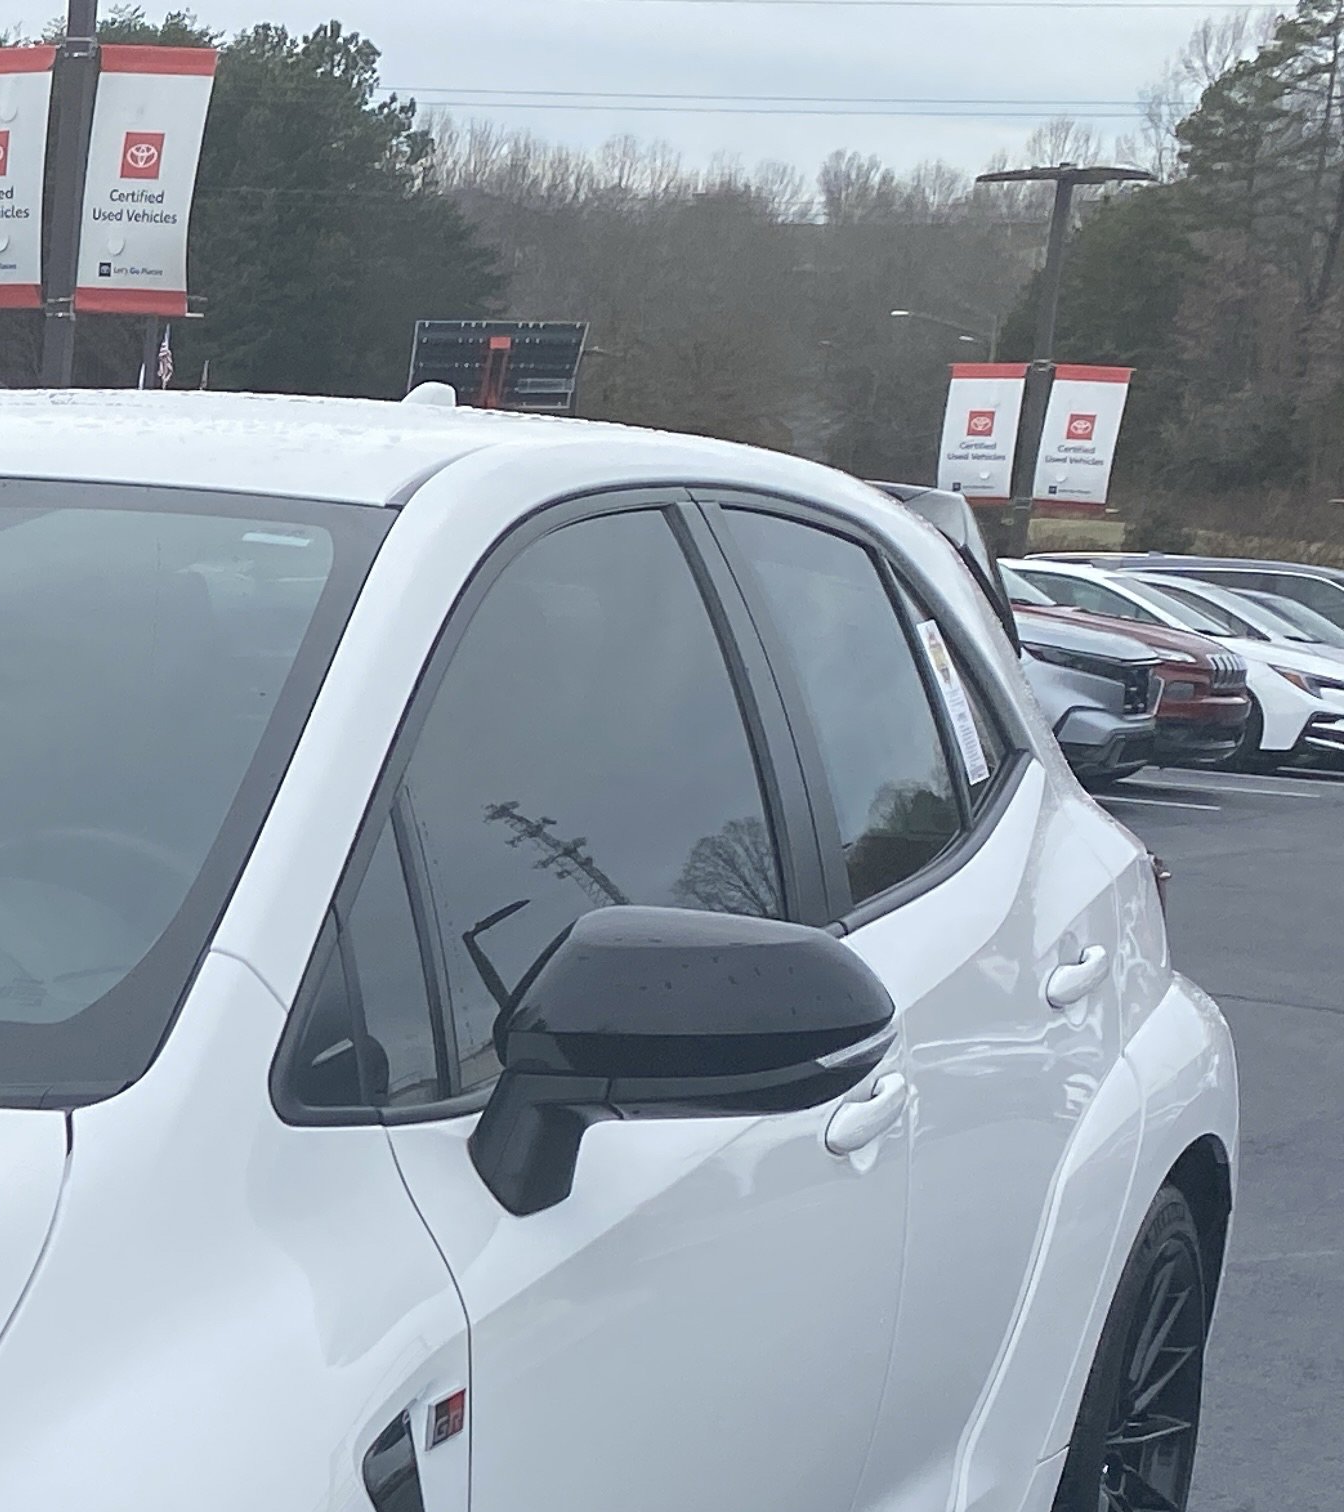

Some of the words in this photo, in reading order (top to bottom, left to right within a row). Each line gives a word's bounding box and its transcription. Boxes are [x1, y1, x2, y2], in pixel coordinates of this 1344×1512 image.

[109, 188, 165, 204] Certified
[92, 207, 123, 221] Used
[126, 208, 178, 224] Vehicles
[1057, 445, 1096, 454] Certified
